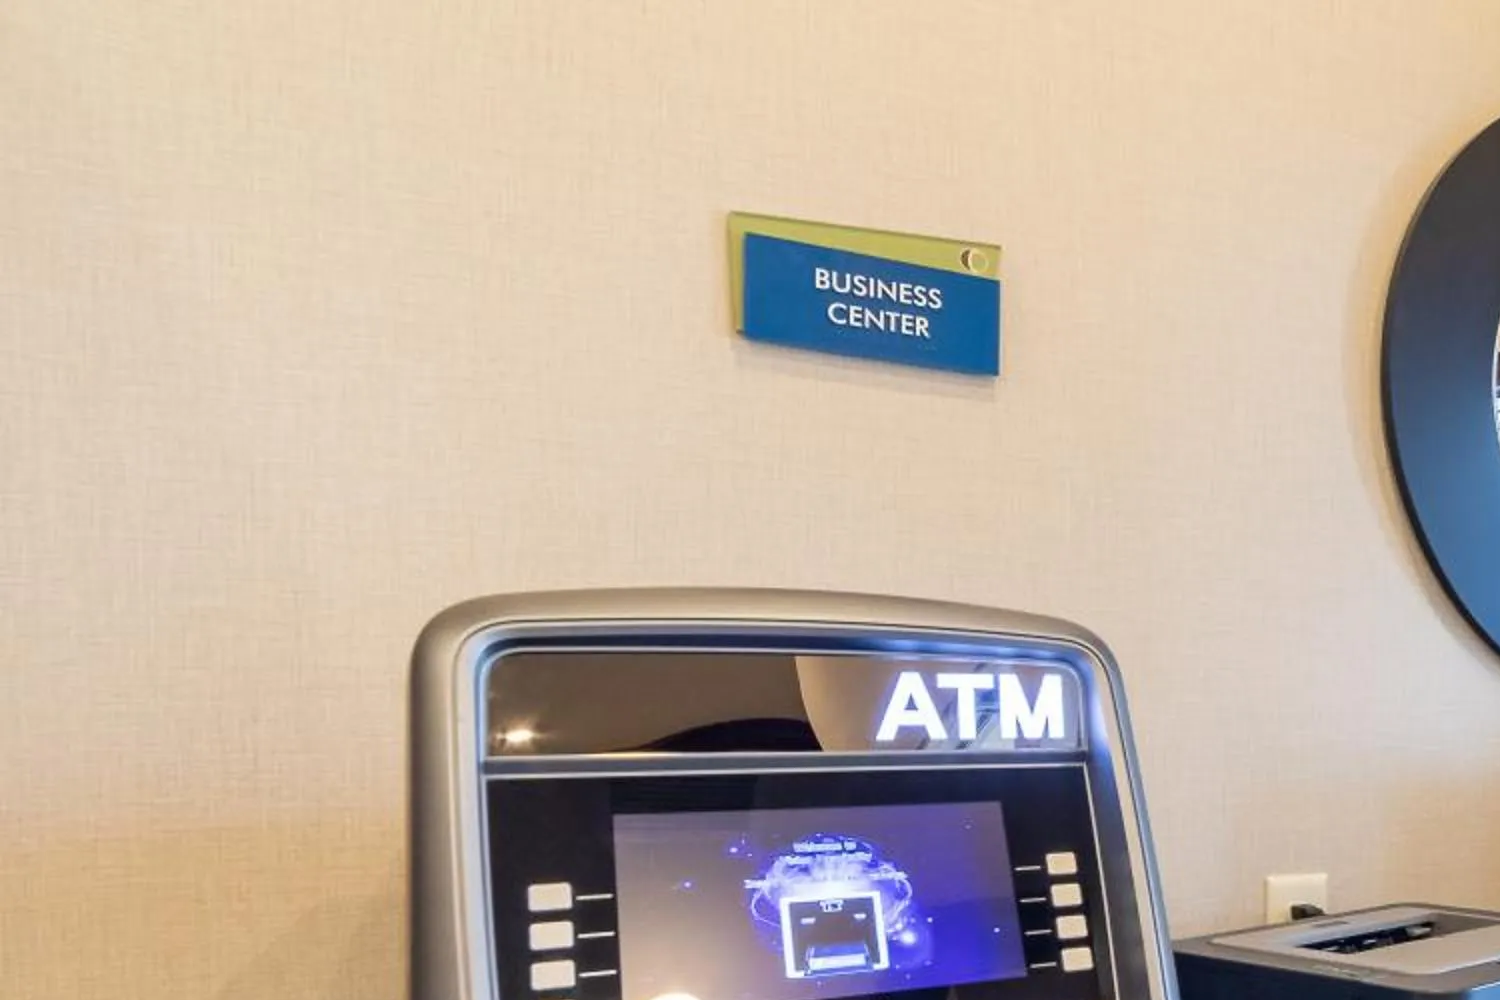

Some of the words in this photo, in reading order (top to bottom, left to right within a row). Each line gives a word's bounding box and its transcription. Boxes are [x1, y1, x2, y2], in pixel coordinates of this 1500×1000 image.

[815, 267, 942, 309] BUSINESS
[827, 301, 930, 338] CENTER
[875, 671, 1065, 741] ATM
